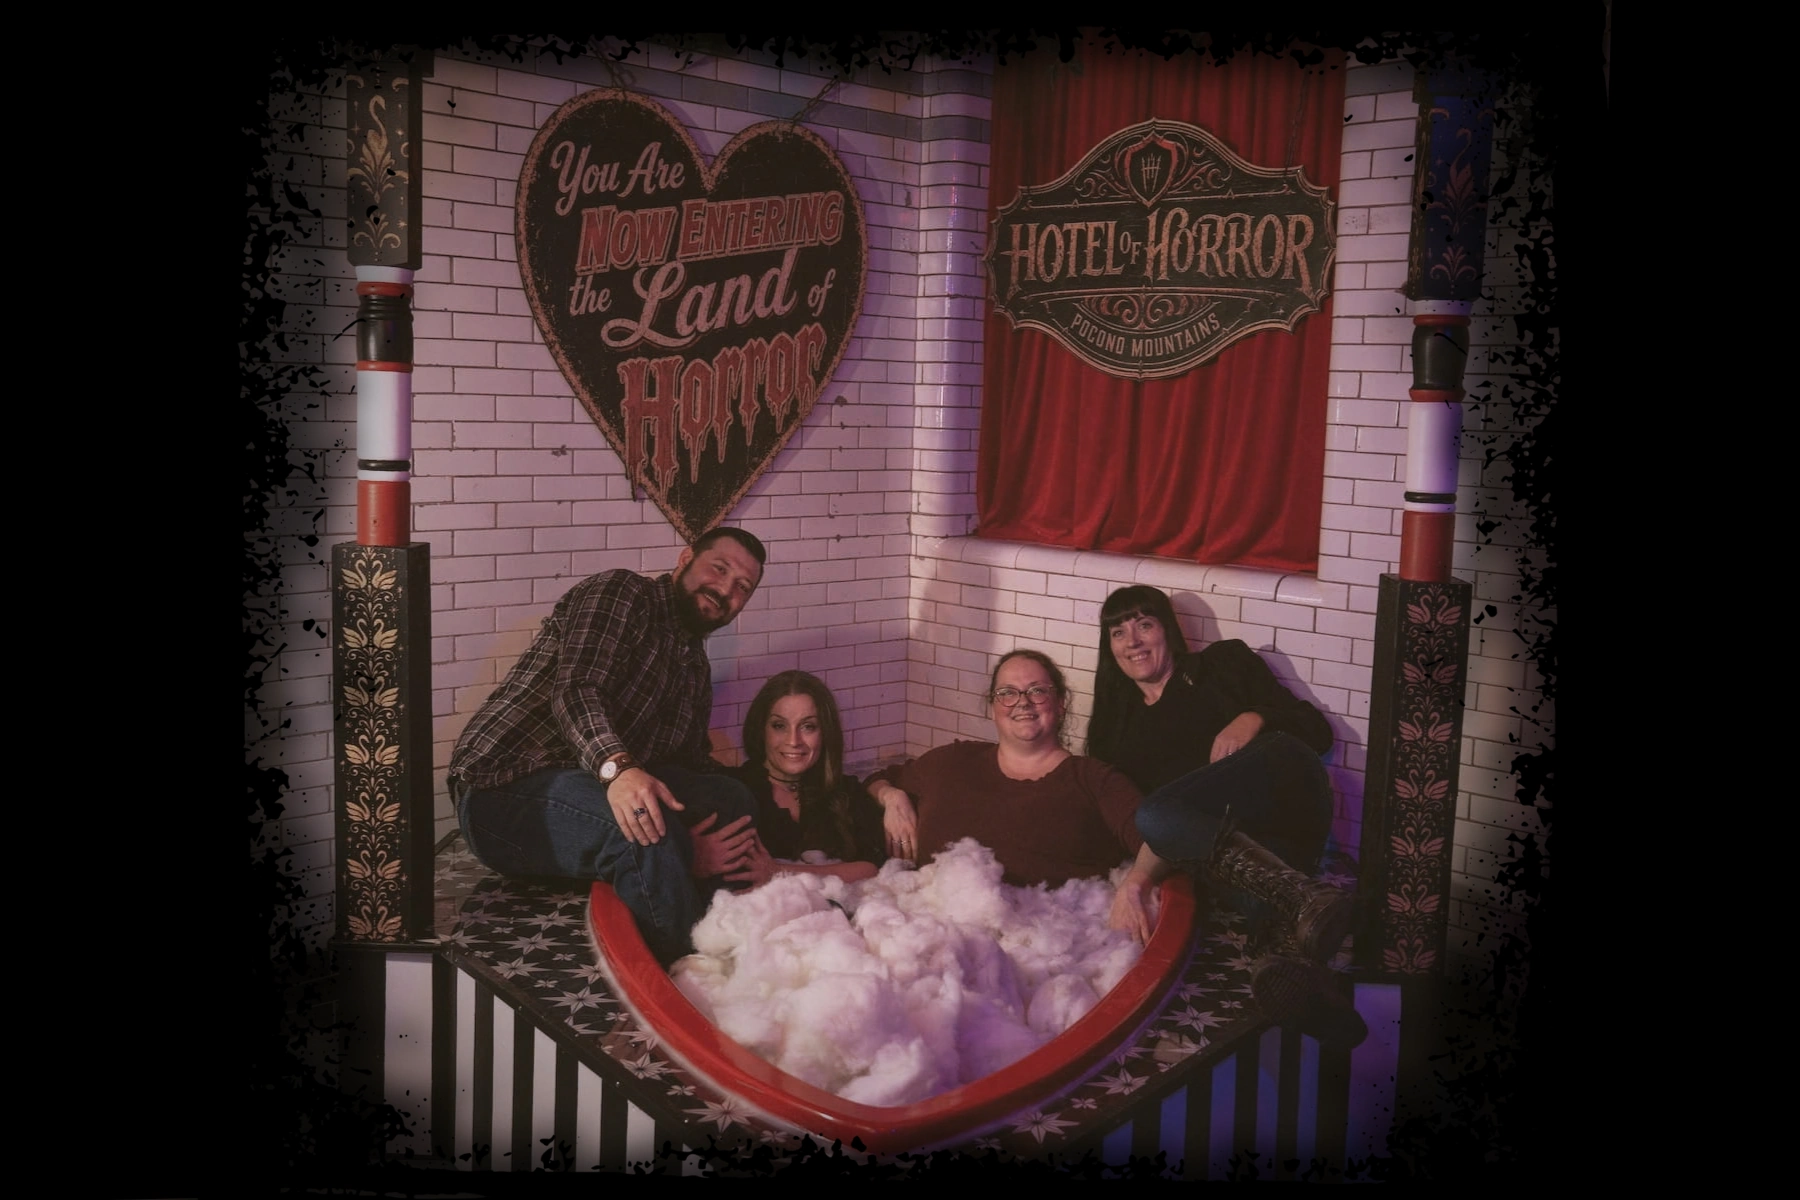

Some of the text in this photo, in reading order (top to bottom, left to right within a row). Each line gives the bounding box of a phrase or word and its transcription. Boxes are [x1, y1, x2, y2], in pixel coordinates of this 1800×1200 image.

[550, 140, 685, 216] You Are
[575, 190, 845, 276] NOW ENTERING
[1001, 207, 1318, 303] HOTEL OF HORROR
[569, 249, 836, 350] the Land of
[1070, 312, 1221, 357] POCONO MOUNTAINS
